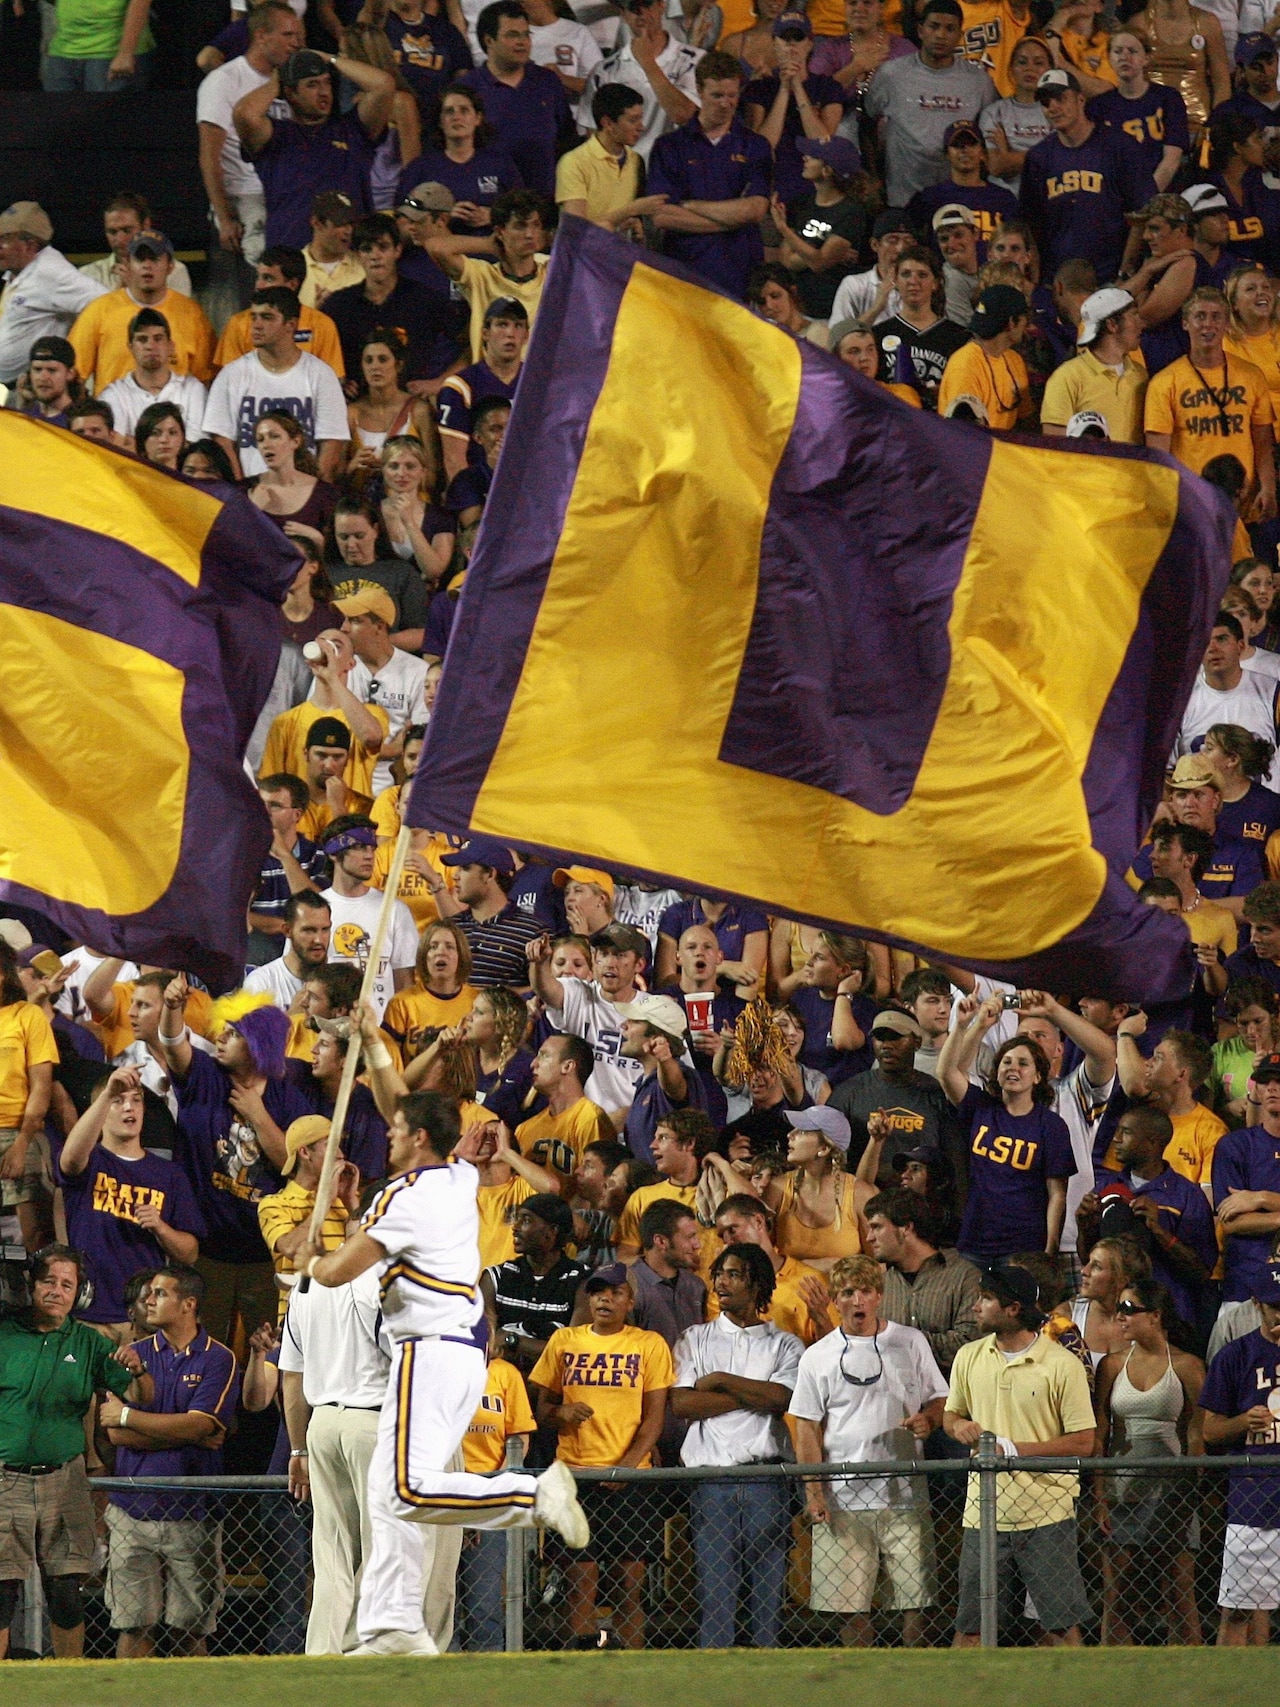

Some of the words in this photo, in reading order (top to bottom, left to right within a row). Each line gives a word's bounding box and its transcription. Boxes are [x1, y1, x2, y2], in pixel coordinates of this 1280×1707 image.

[1046, 169, 1104, 200] LSU
[1179, 385, 1248, 409] GATOR
[382, 691, 405, 701] LSU
[1243, 822, 1267, 837] LSU
[1212, 863, 1234, 872] LSU
[516, 892, 537, 907] LSU
[336, 926, 356, 936] LSU
[593, 1051, 641, 1069] GERS
[972, 1125, 1038, 1171] LSU
[1177, 1147, 1197, 1166] LSU
[533, 1138, 577, 1176] SU
[95, 1170, 166, 1214] DEATH
[563, 1353, 641, 1370] DEATH
[182, 1374, 203, 1383] LSU
[562, 1369, 640, 1388] VALLEY
[466, 1422, 497, 1434] GERS
